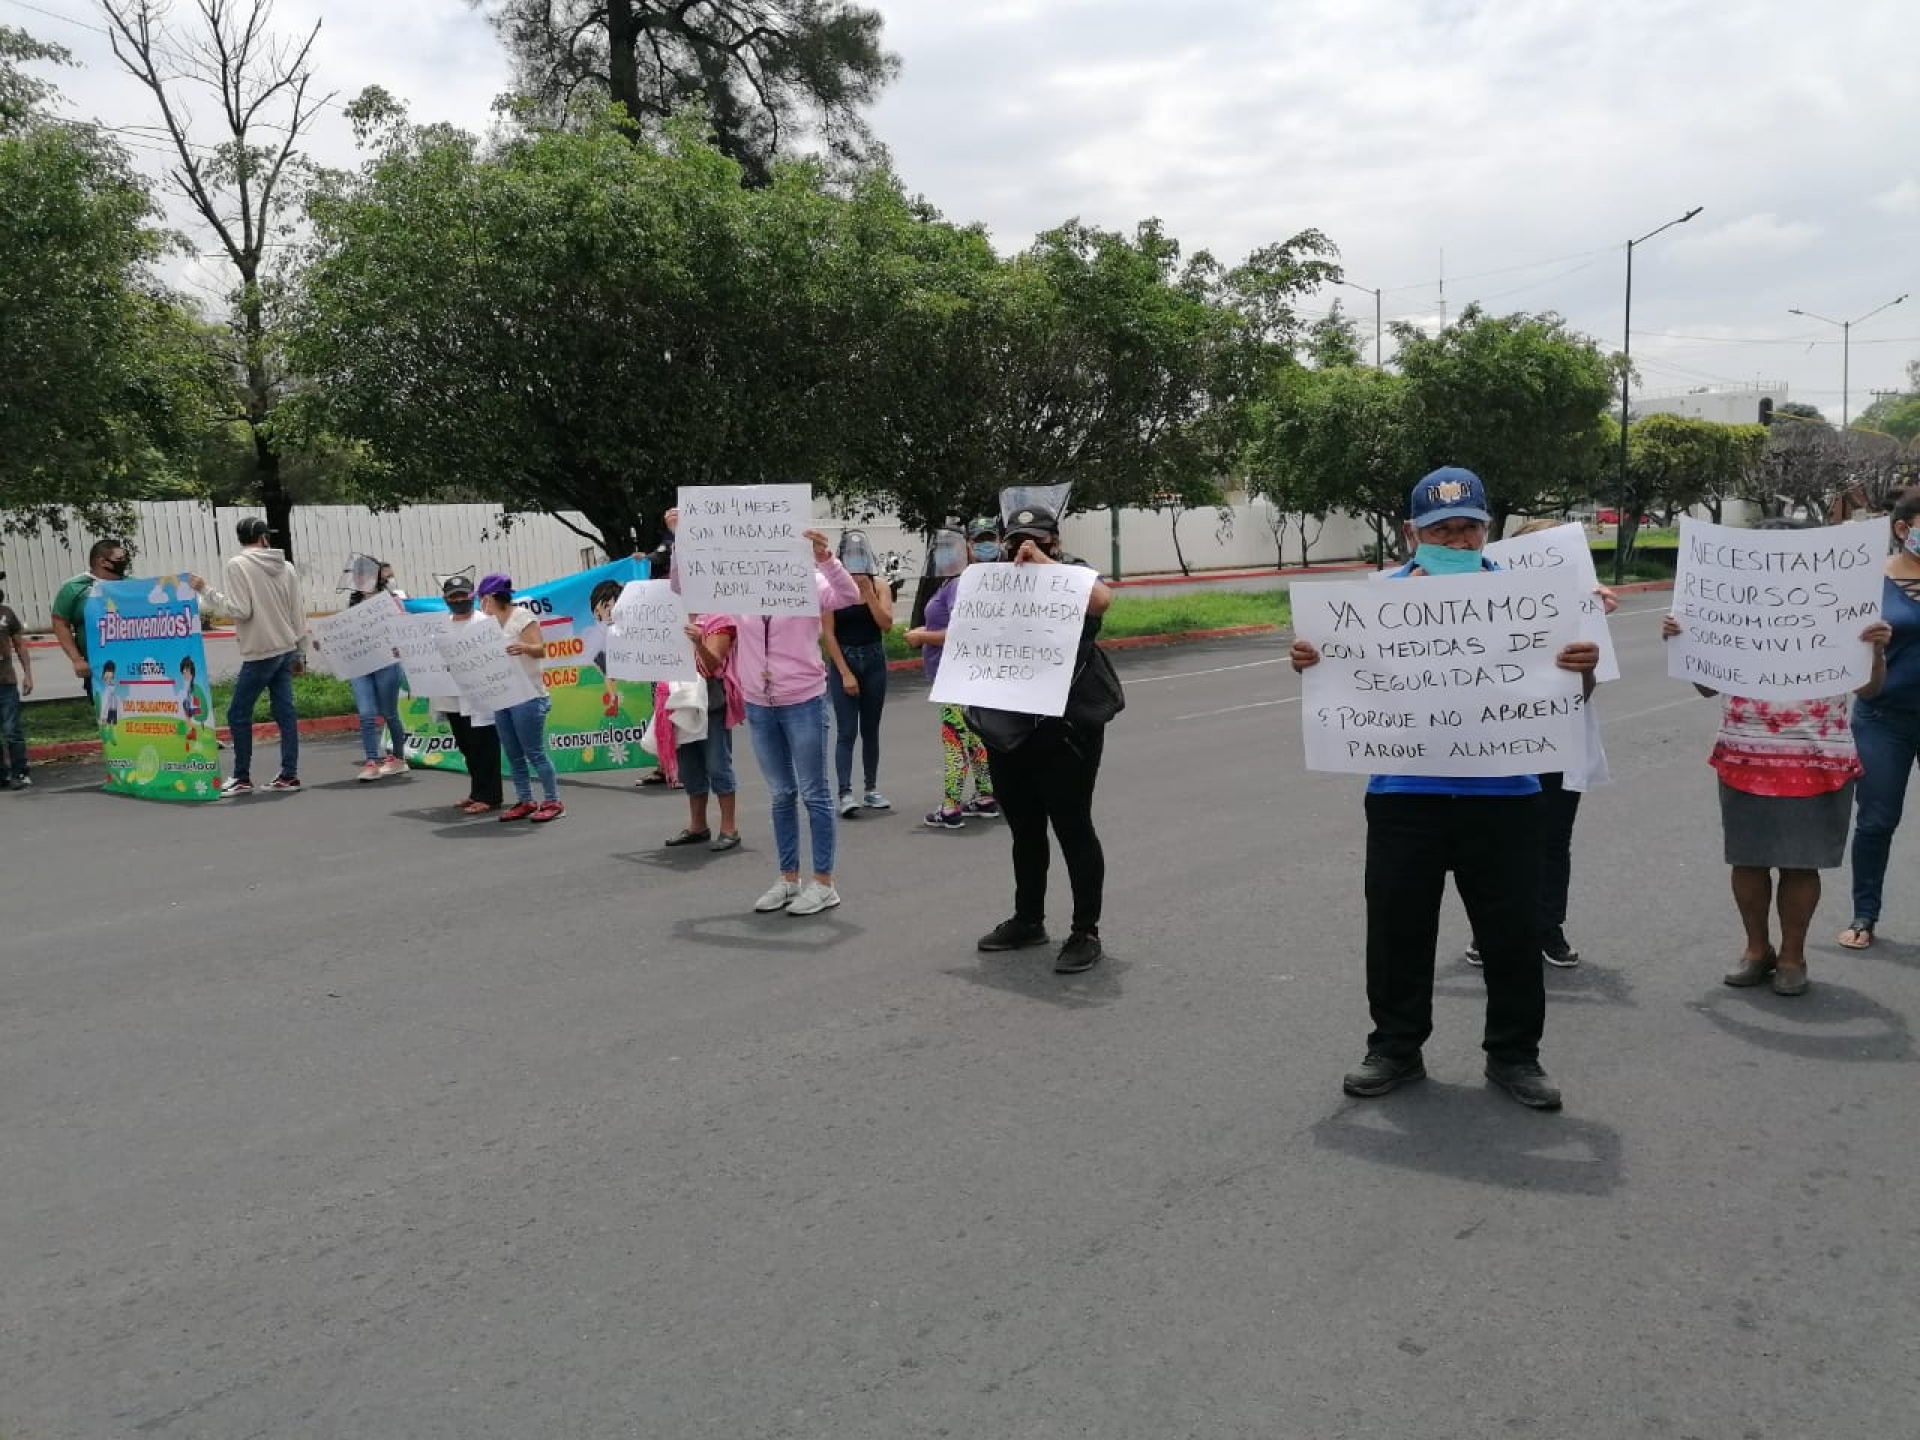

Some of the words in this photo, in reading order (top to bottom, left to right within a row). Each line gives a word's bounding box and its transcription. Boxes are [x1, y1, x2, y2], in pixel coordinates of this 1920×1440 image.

[684, 502, 698, 516] YA
[731, 498, 740, 516] 4
[744, 499, 791, 514] MESES
[689, 526, 714, 540] SIN
[723, 524, 796, 540] TRABAJAR
[1691, 534, 1870, 573] NECESITAMOS
[688, 560, 706, 577] YA
[711, 560, 808, 578] NECESITAMOS
[977, 573, 1037, 594] ABRAN
[1052, 575, 1077, 593] EL
[1684, 572, 1839, 607] RECURSOS
[957, 601, 1006, 619] PARQUE
[1011, 602, 1081, 621] ALAMEDA
[1328, 600, 1366, 632] YA
[1378, 593, 1560, 629] CONTAMOS
[1684, 603, 1816, 629] ECONOMICOS
[1836, 601, 1880, 623] PARA
[100, 606, 192, 648] ¡Bienvenidos!
[1690, 626, 1835, 652] SOBREVIVIR
[953, 641, 971, 660] YA
[976, 644, 992, 658] NO
[996, 644, 1064, 665] TENEMOS
[1321, 643, 1364, 658] CON
[1378, 638, 1486, 658] MEDIDAS
[1508, 630, 1549, 652] DE
[1353, 664, 1525, 691] SEGURIDAD
[1685, 654, 1748, 685] PARQUE
[1759, 665, 1852, 686] ALAMEDA
[1429, 709, 1462, 727] NO
[1481, 694, 1584, 723] ABREN?
[1349, 740, 1427, 757] PARQUE
[1449, 736, 1558, 757] ALAMEDA
